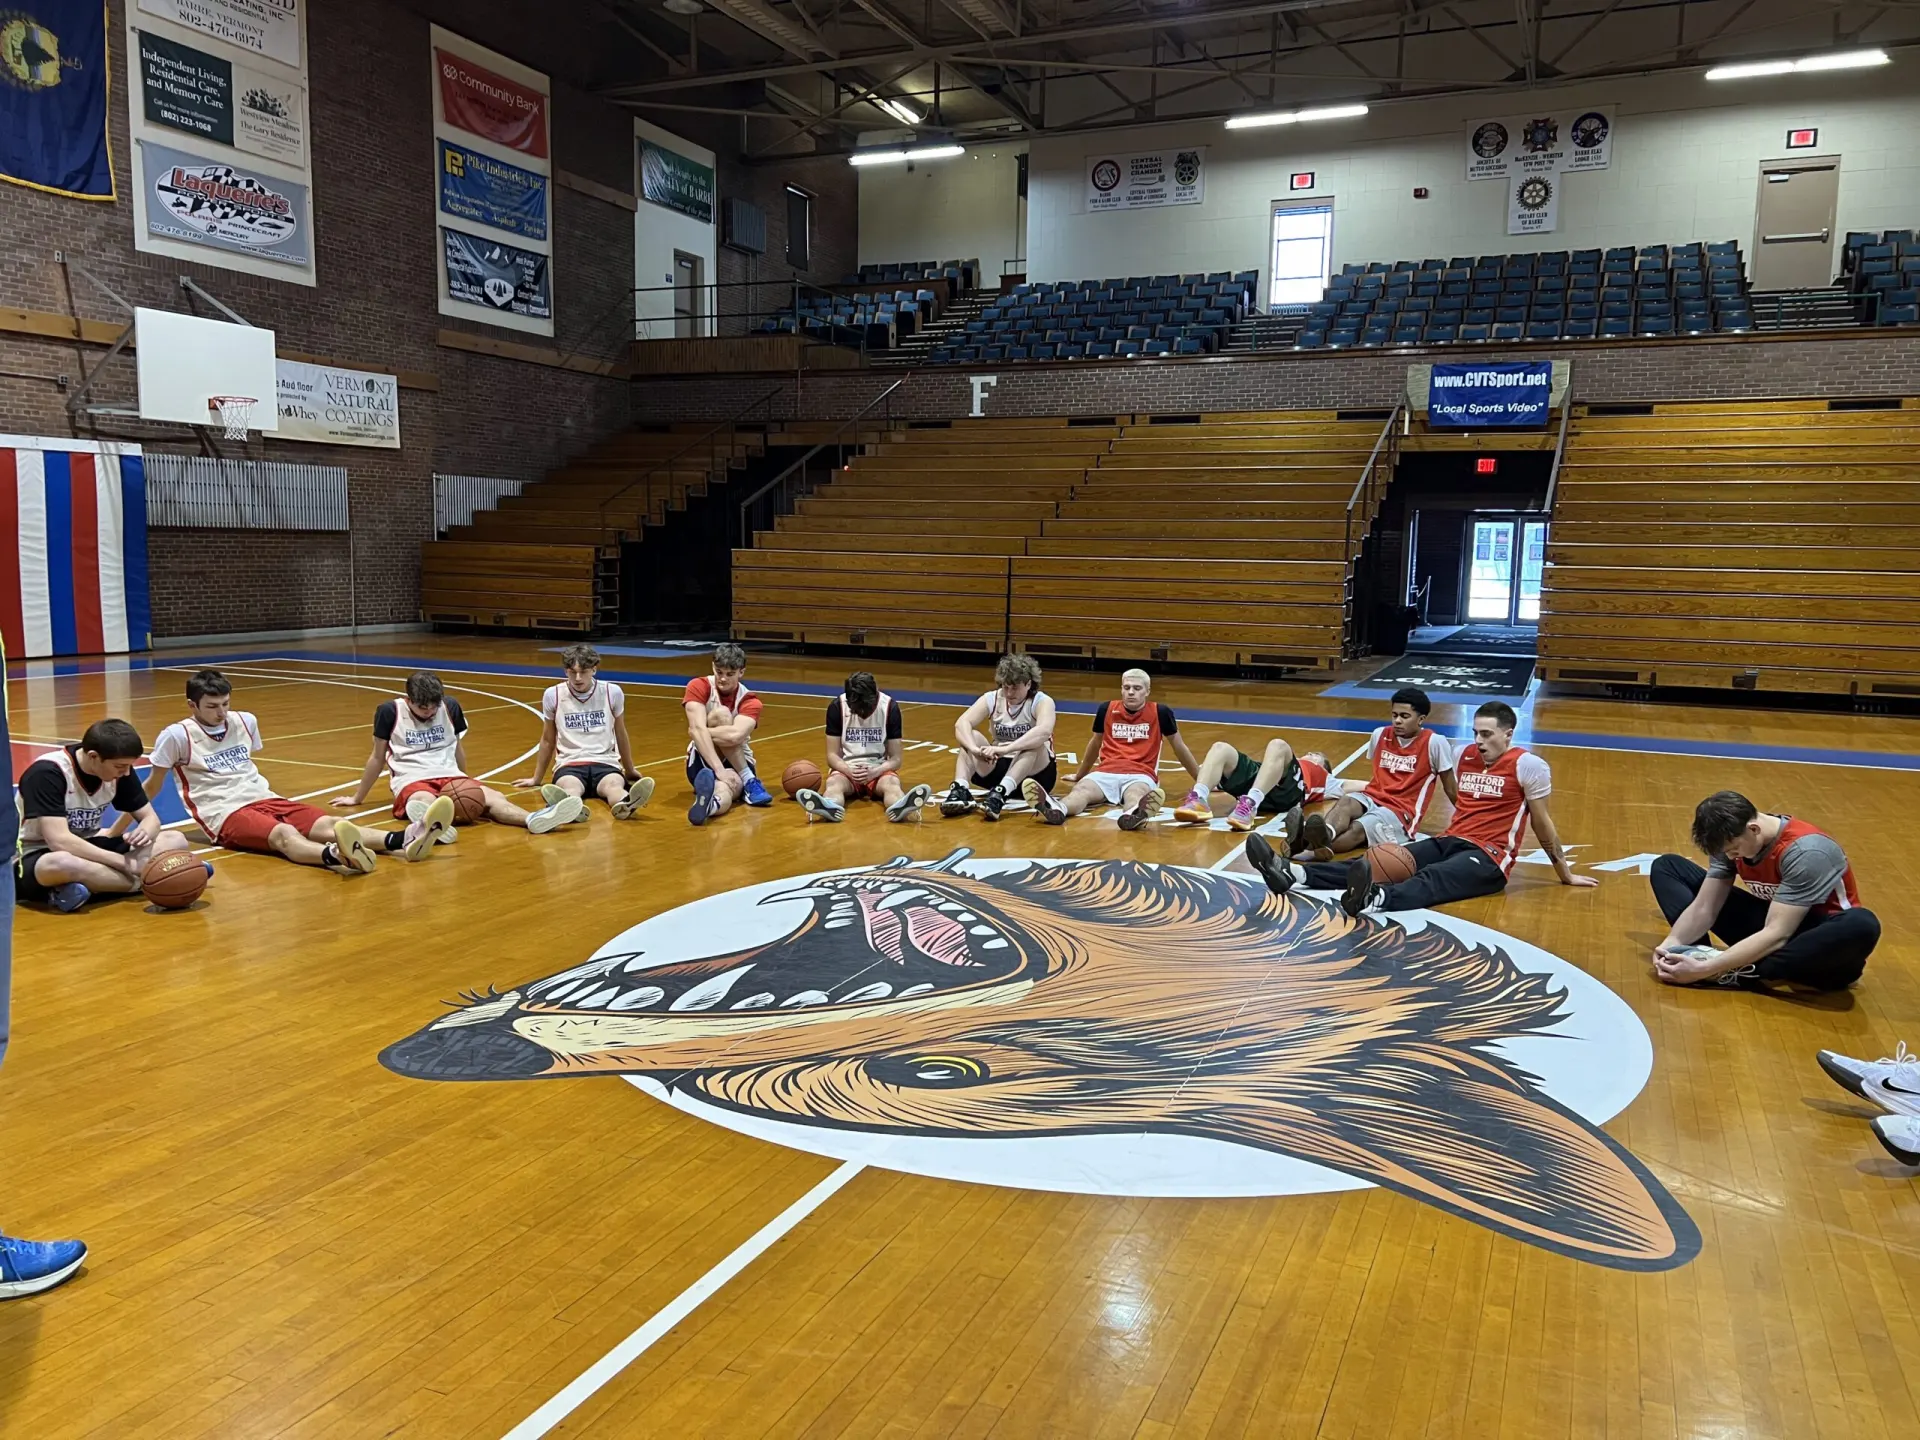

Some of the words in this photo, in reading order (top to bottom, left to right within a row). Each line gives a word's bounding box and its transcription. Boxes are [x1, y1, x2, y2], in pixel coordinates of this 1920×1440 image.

[230, 4, 269, 24] RESIDENTIAL
[216, 11, 265, 37] VERMONT
[142, 47, 196, 75] Independent
[198, 67, 227, 88] Living,
[149, 63, 196, 88] Residential
[198, 81, 221, 98] Care,
[146, 78, 162, 89] and
[164, 81, 202, 104] Memory
[203, 95, 224, 109] Care
[459, 71, 516, 107] Community
[516, 95, 540, 115] Bank
[160, 109, 179, 123] (802)
[180, 115, 212, 132] 223-1068
[240, 120, 253, 130] The
[270, 129, 301, 145] Residence
[466, 153, 485, 171] Pike
[171, 167, 290, 215] Laquerre's
[689, 185, 712, 206] BARRE
[177, 210, 223, 225] POLARIS
[219, 228, 250, 240] MERCURY
[228, 222, 281, 239] PRINCECRAFT
[281, 379, 296, 390] Aud
[296, 381, 314, 392] floor
[325, 373, 394, 396] VERMONT
[1434, 371, 1547, 388] www.CVTSport.net
[326, 391, 394, 412] NATURAL
[969, 376, 997, 417] F
[1432, 404, 1467, 414] "Local
[1468, 403, 1504, 415] Sports
[1507, 402, 1544, 413] Video"
[325, 408, 394, 427] COATINGS
[1477, 459, 1496, 472] EXIT
[564, 712, 605, 721] HARTFORD
[565, 719, 606, 728] BASKETBALL
[406, 726, 445, 738] HARTFORD
[995, 723, 1032, 732] HARTFORD
[1112, 723, 1150, 731] HARTFORD
[204, 746, 248, 765] HARTFORD
[208, 754, 250, 771] BASKETBALL
[1381, 751, 1417, 764] HARTFORD
[1380, 759, 1416, 772] BASKETBALL
[1459, 782, 1503, 795] BASKETBALL
[1460, 774, 1505, 788] HARTFORD
